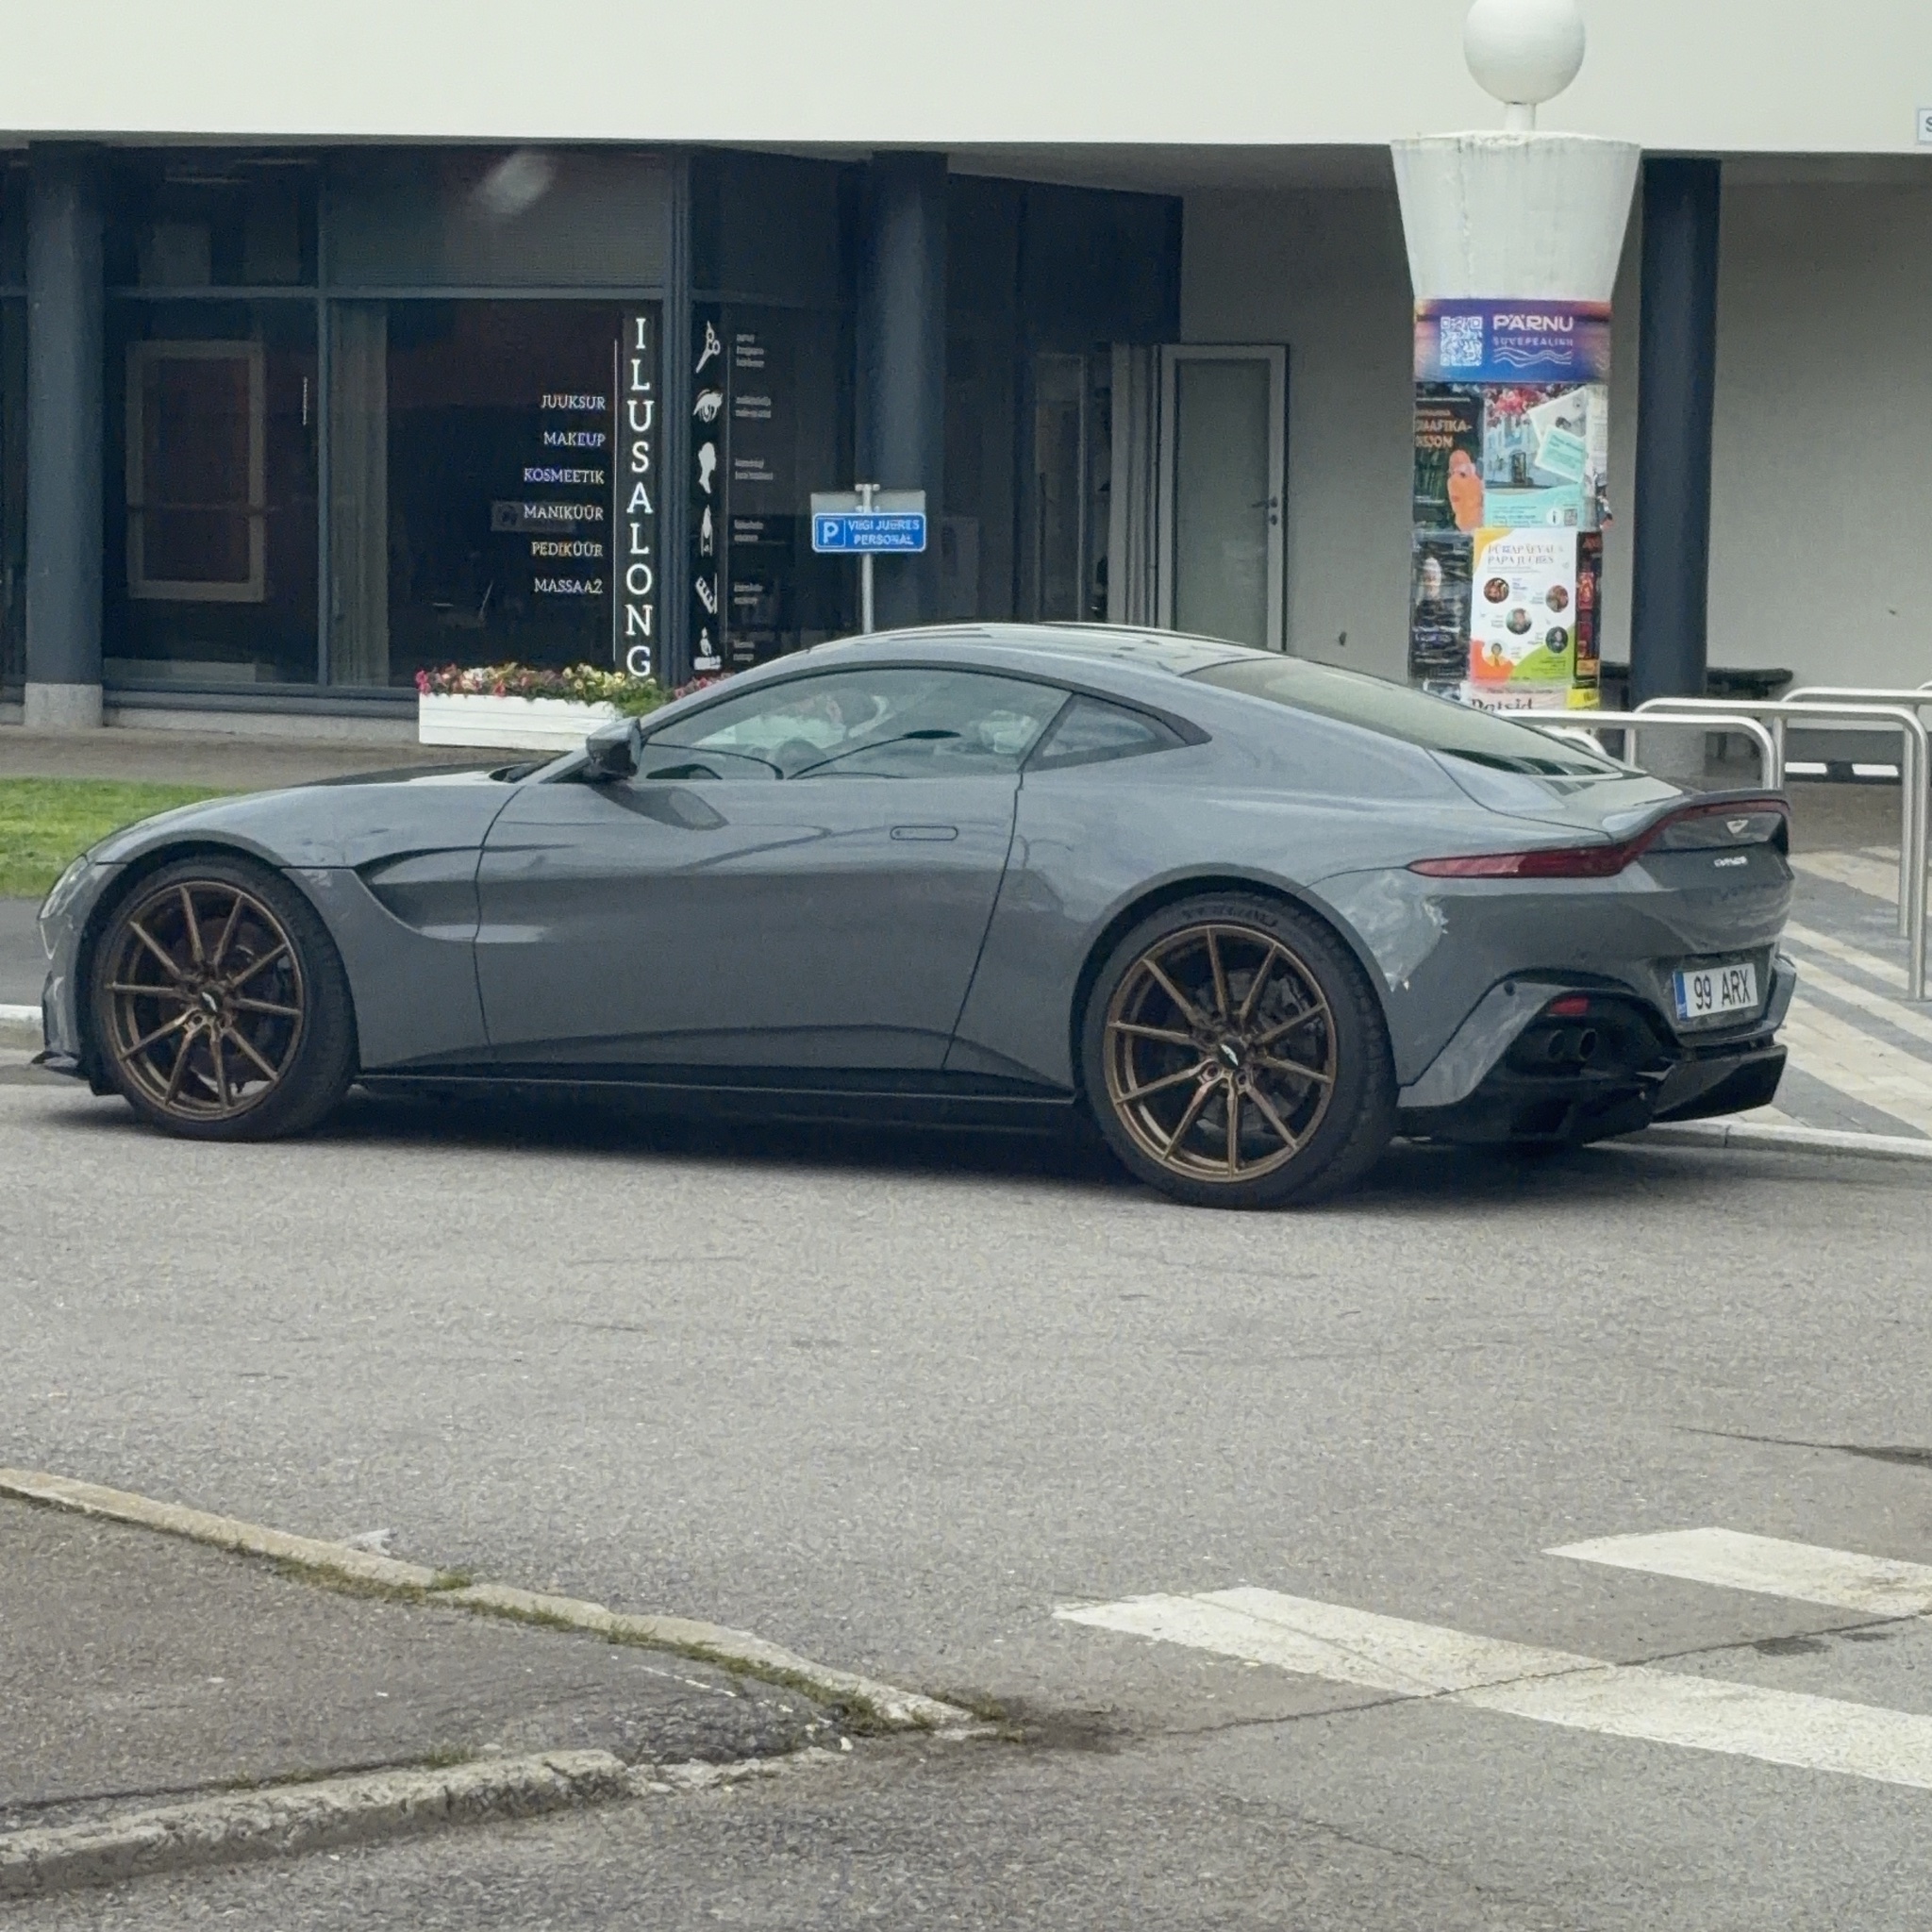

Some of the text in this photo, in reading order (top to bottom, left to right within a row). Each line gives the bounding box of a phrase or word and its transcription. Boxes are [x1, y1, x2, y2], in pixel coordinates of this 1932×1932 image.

[1493, 314, 1574, 332] PÄRNU
[543, 431, 606, 446] MAKEUP
[524, 468, 606, 485] KOSMEETIK
[625, 317, 655, 677] ILUSALONG
[823, 521, 839, 544] P
[1488, 555, 1515, 565] PAPA
[1693, 969, 1751, 1010] 99 ARX
